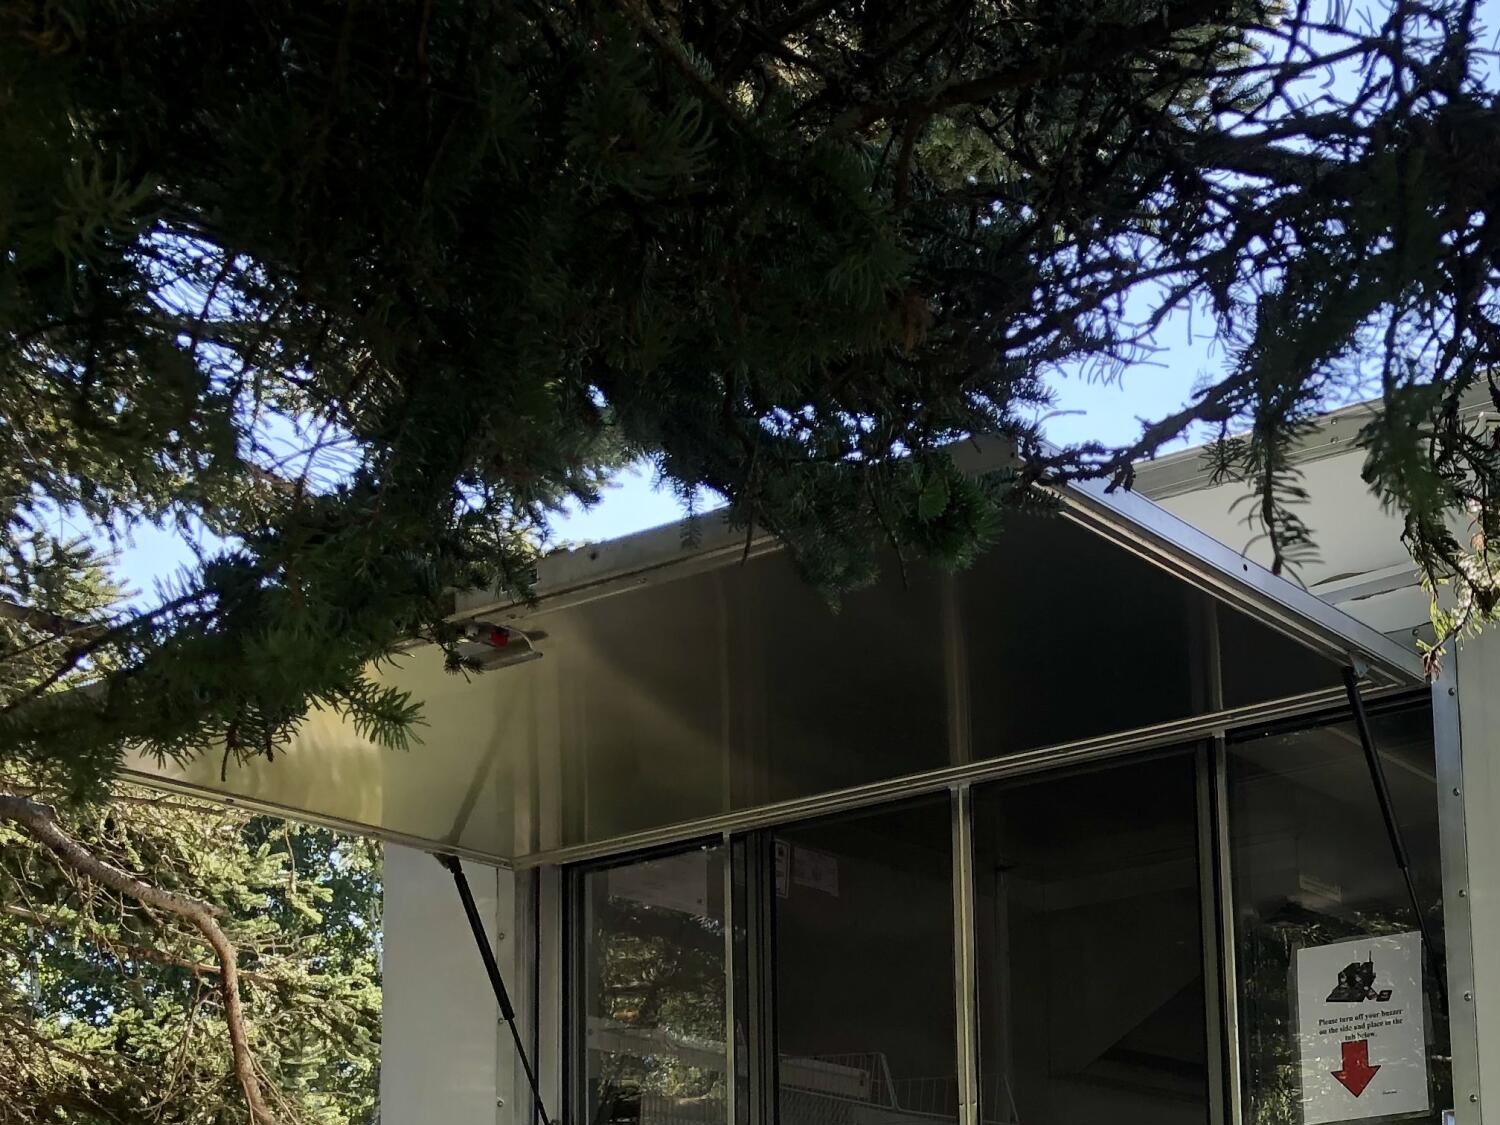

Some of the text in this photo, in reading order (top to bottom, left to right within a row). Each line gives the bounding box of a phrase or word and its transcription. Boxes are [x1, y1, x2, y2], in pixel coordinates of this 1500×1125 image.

[1319, 1018, 1338, 1026] Please
[1365, 1012, 1380, 1021] your
[1354, 1022, 1365, 1030] and
[1367, 1021, 1384, 1030] place
